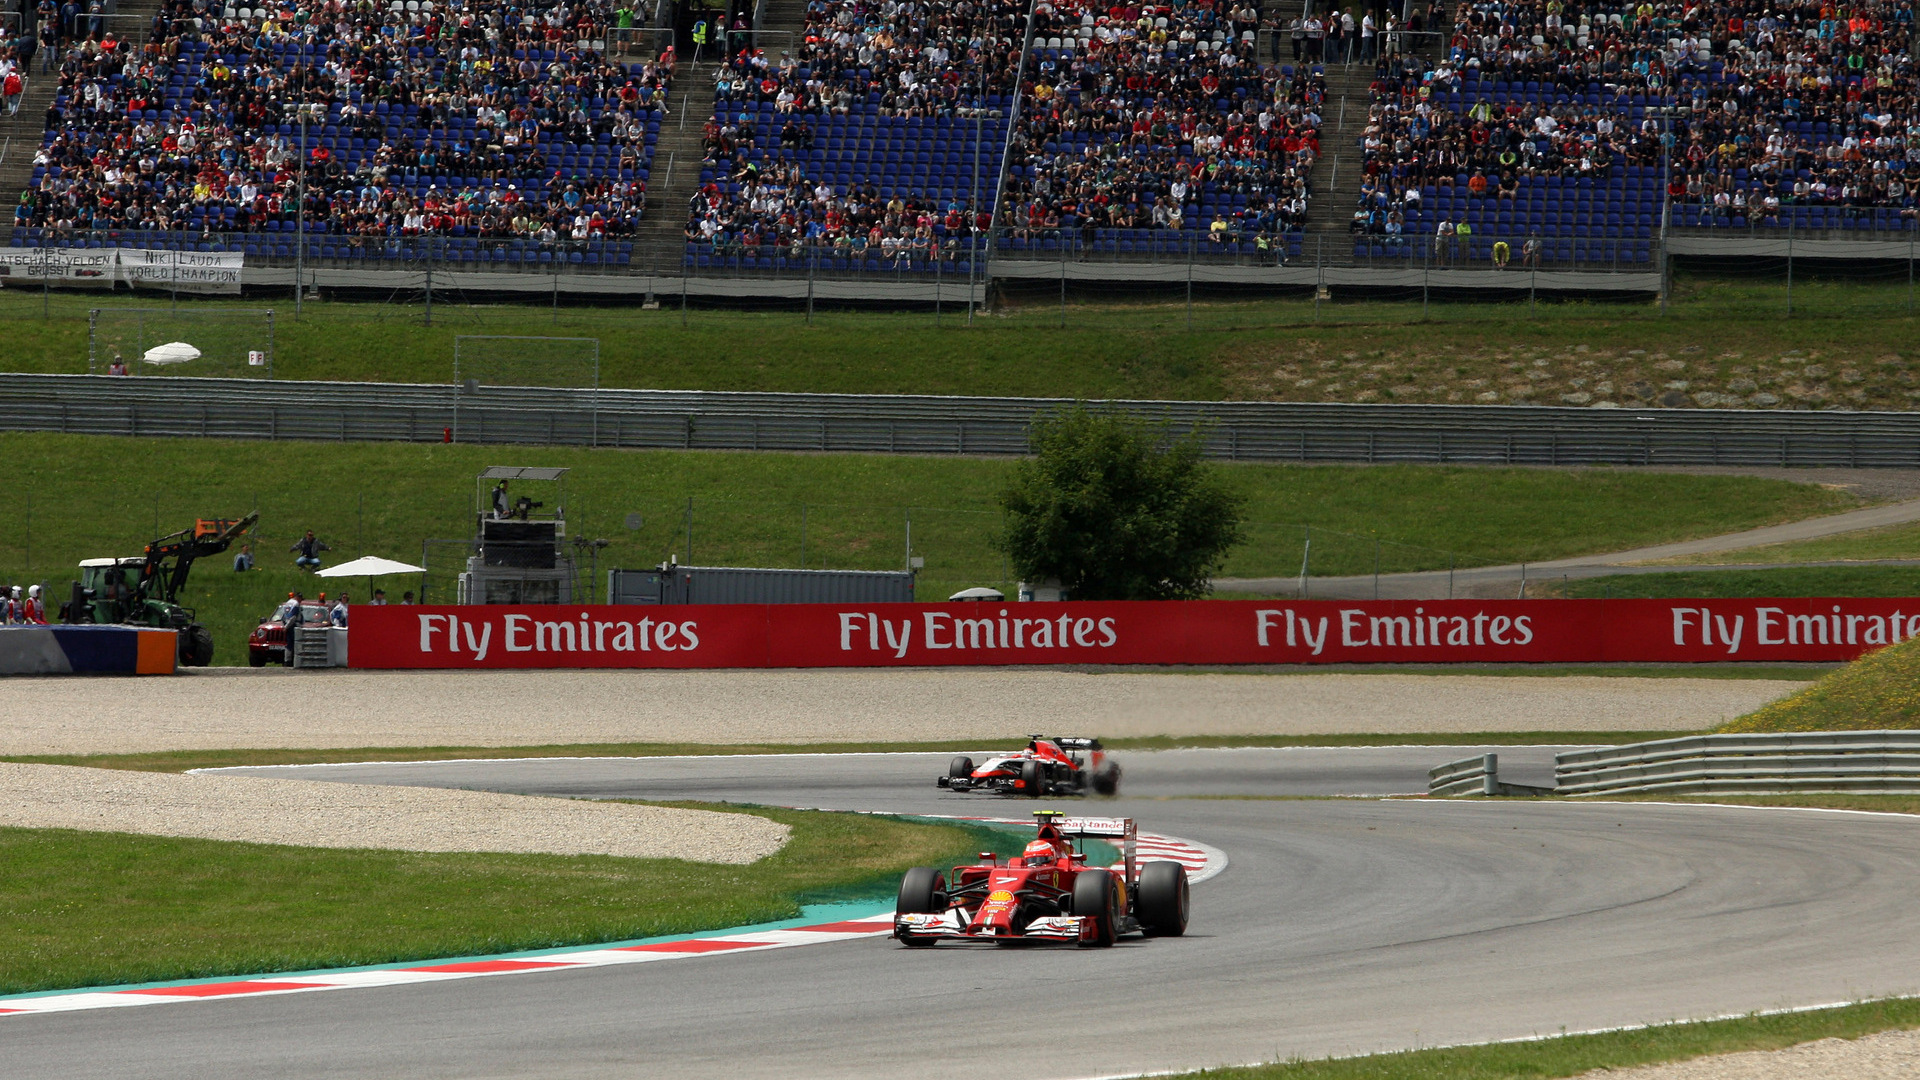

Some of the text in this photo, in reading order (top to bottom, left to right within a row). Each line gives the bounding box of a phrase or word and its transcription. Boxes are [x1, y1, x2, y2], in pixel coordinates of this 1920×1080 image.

[128, 266, 237, 282] WORLD CHAMPION
[179, 252, 221, 266] LAUDA
[418, 612, 699, 660] Fly Emirates
[838, 609, 1117, 658] Fly Emirates
[1255, 607, 1533, 655] Fly Emirates
[1671, 607, 1744, 653] Fly
[1064, 818, 1123, 829] Santande
[995, 876, 1019, 885] 7
